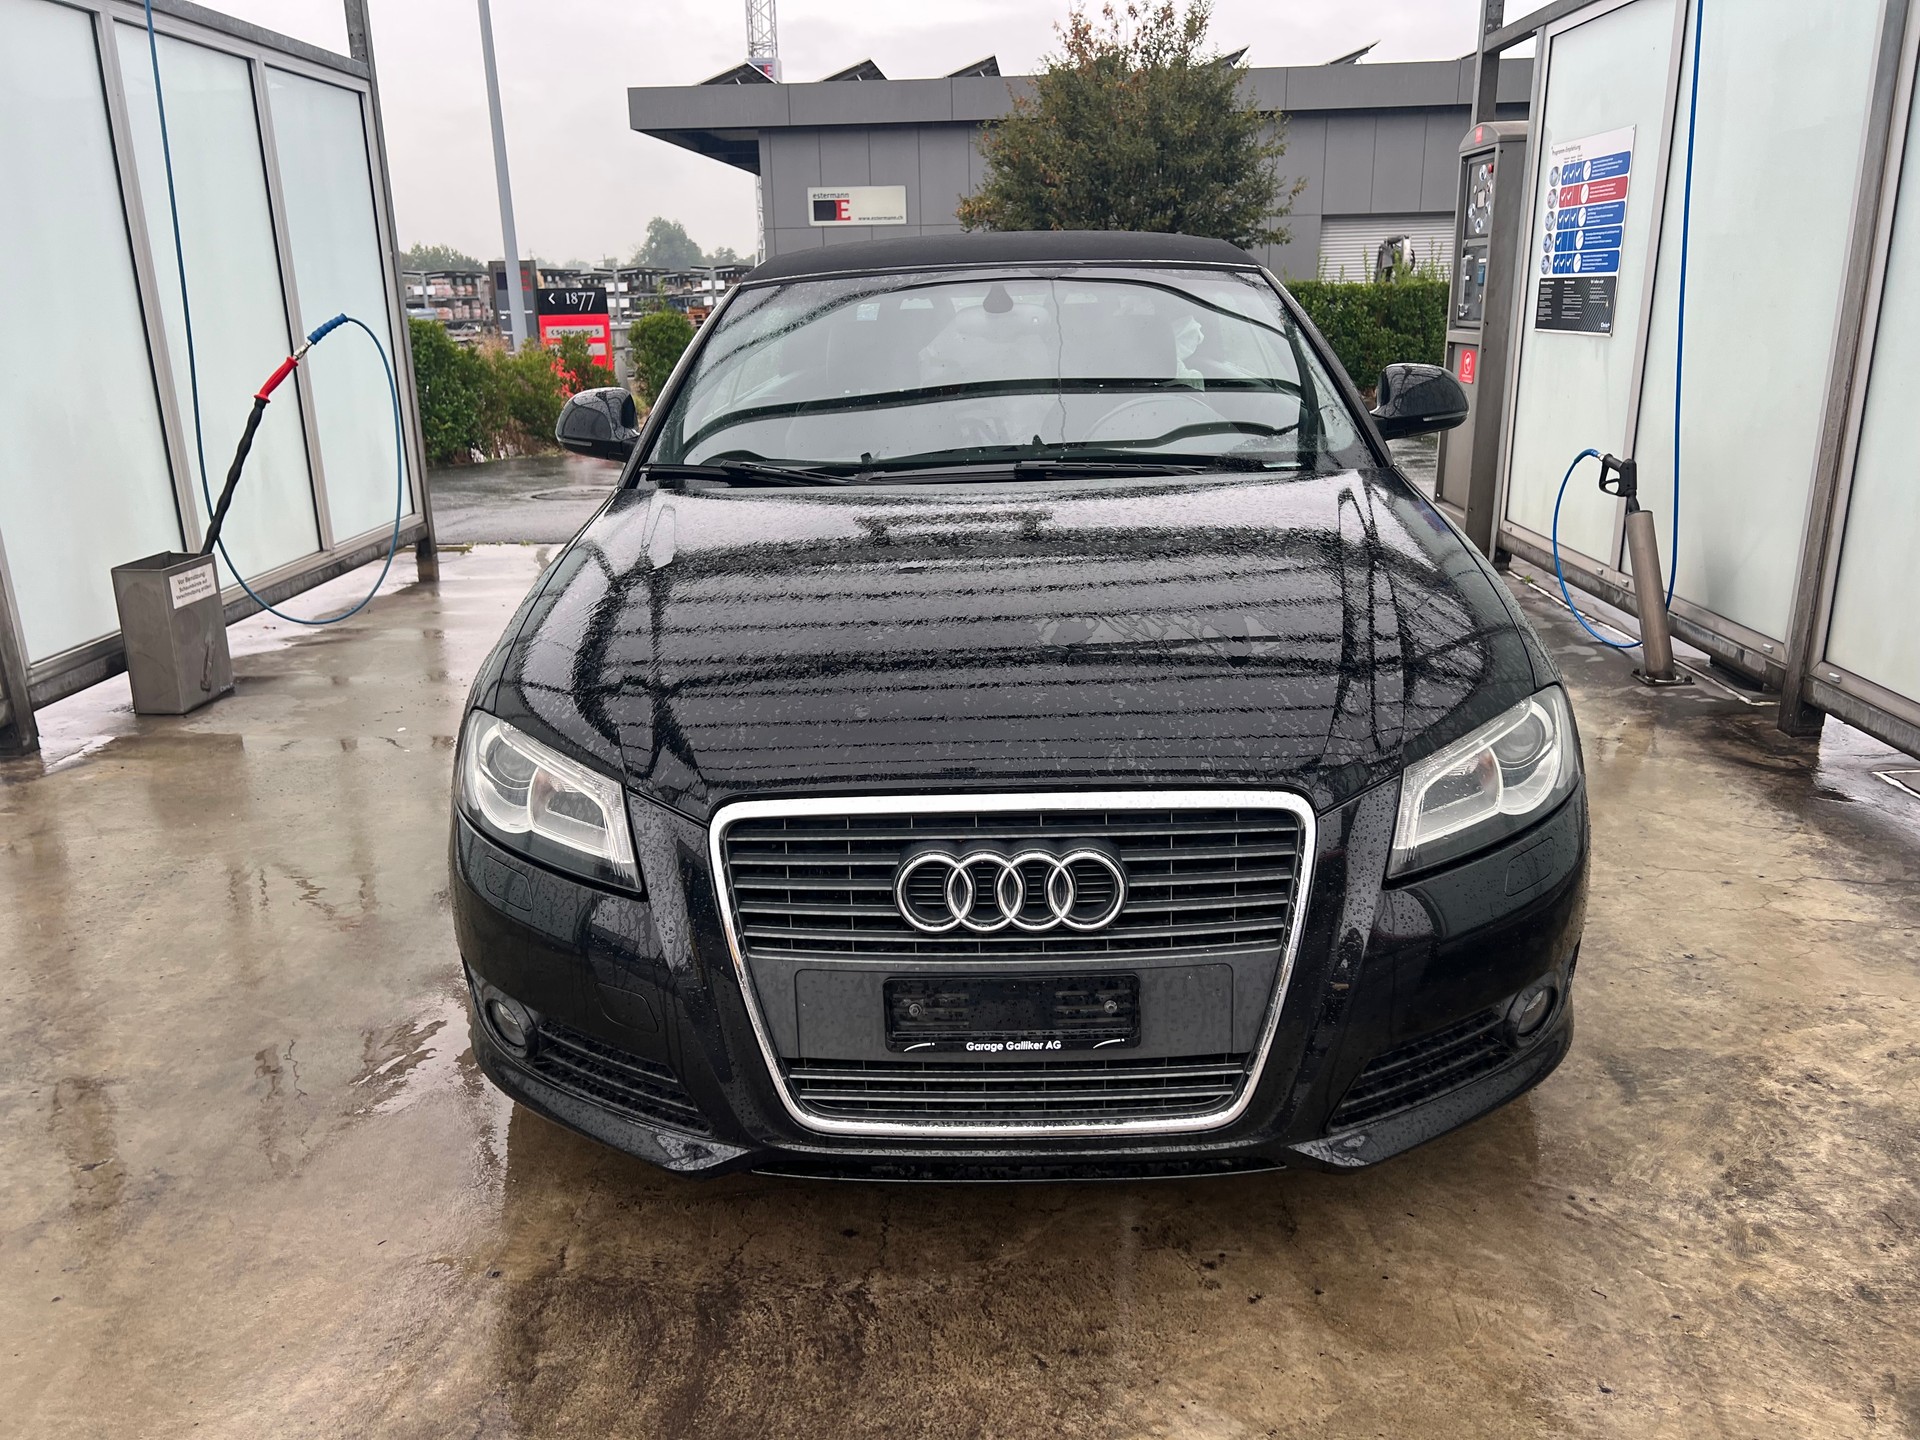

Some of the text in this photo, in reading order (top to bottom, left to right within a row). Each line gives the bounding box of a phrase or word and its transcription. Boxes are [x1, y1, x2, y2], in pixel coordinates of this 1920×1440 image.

[835, 200, 851, 221] E
[565, 291, 596, 311] 1877
[966, 1040, 1061, 1052] Garage Galliker AG
